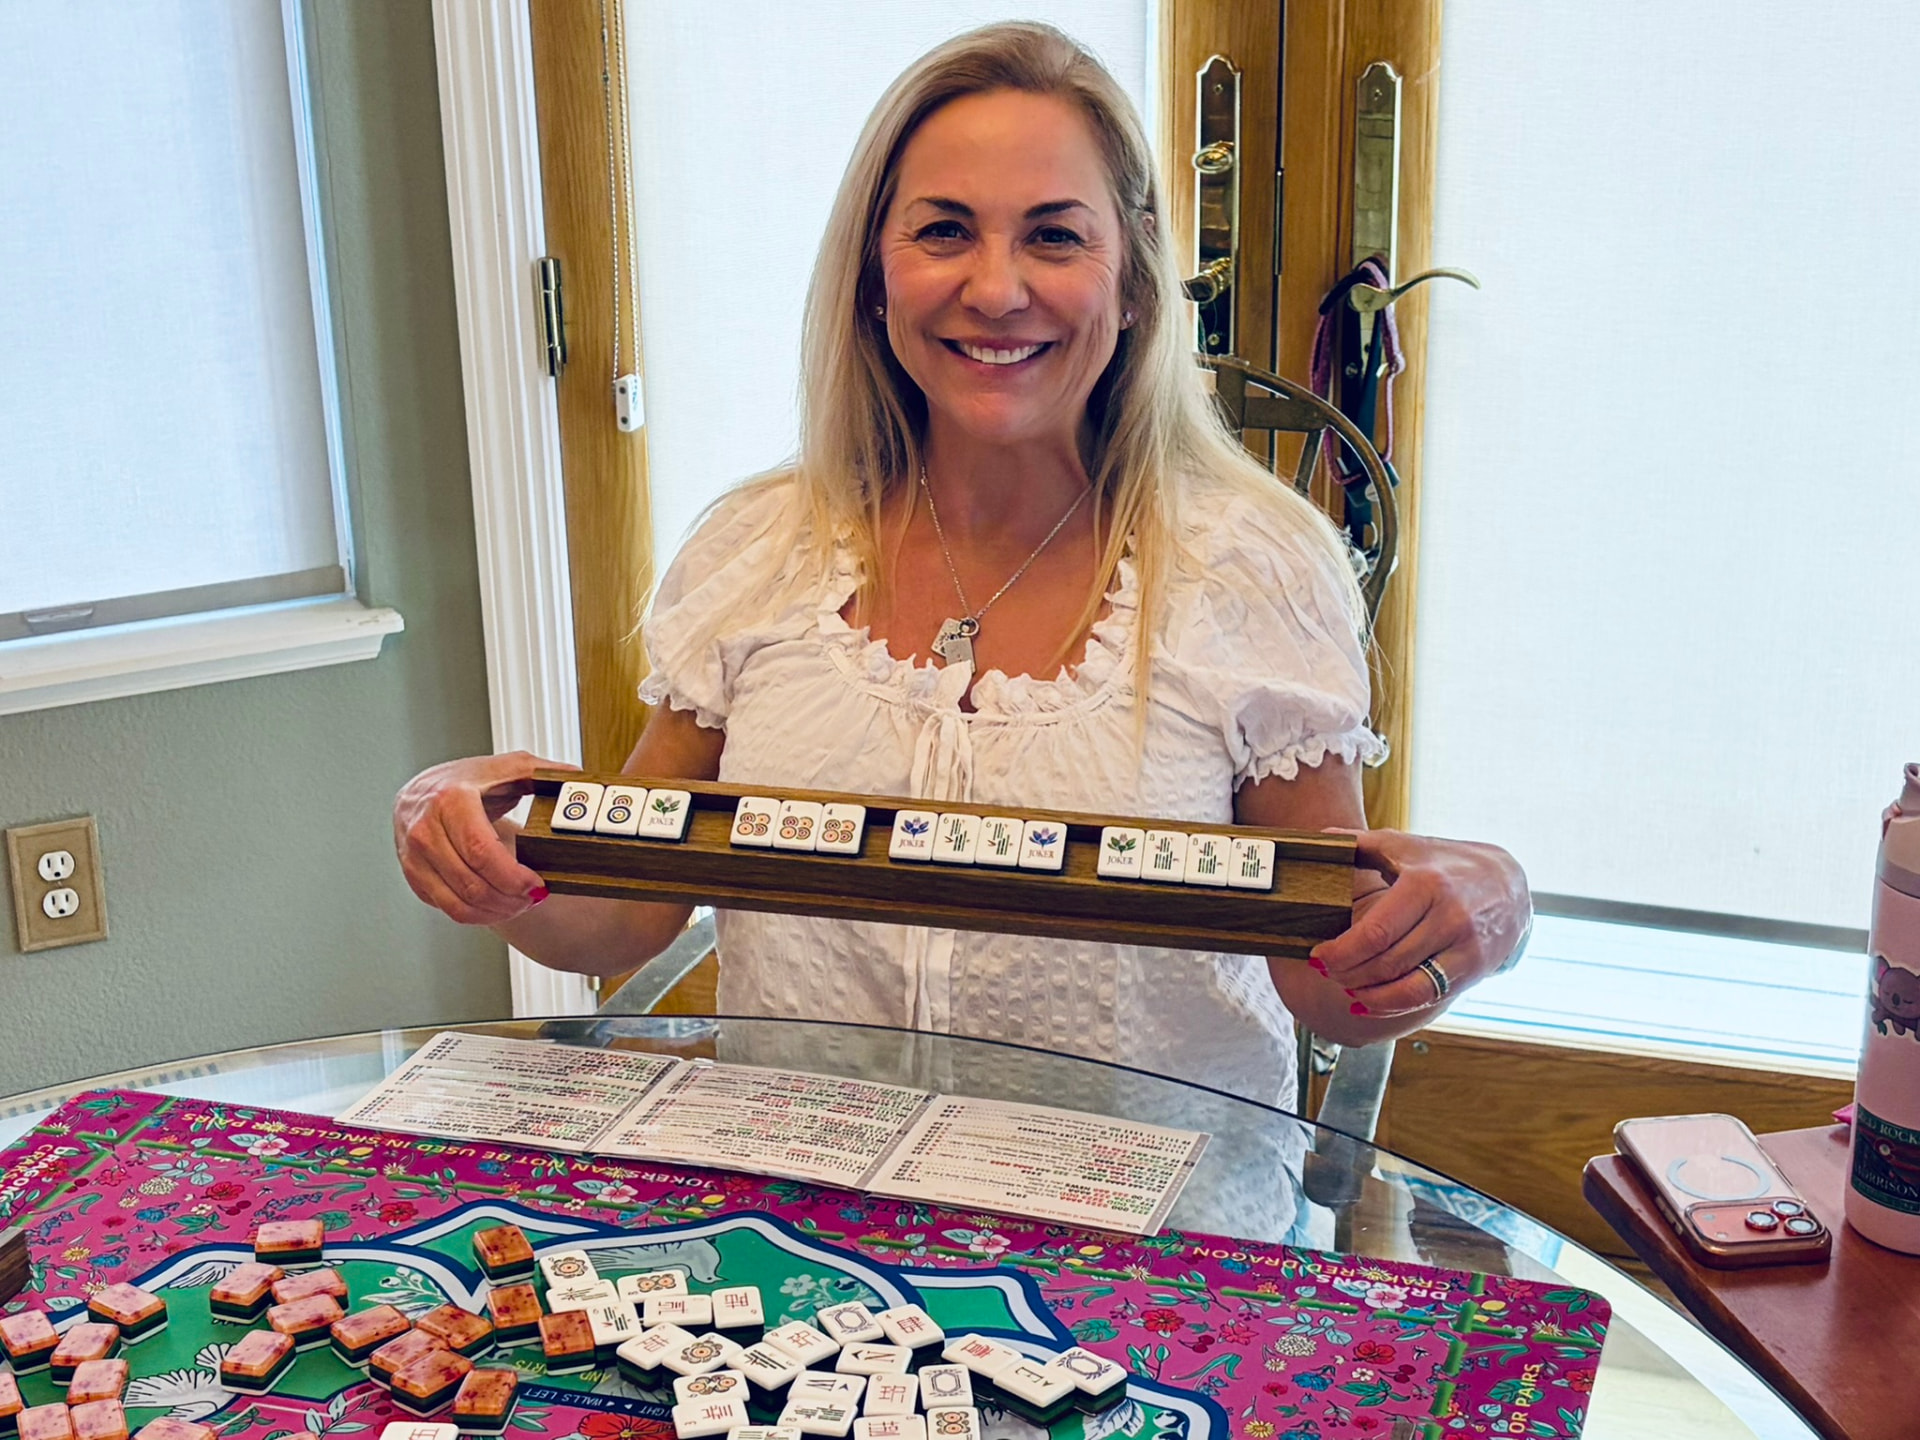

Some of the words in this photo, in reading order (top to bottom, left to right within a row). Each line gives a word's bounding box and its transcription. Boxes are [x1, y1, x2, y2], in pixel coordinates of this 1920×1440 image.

[647, 816, 675, 826] JOKER
[898, 838, 925, 849] JOKER
[1027, 849, 1055, 859] JOKER
[1106, 855, 1134, 866] JOKER
[181, 1113, 247, 1128] PAIRS
[289, 1127, 379, 1146] SINGLES
[1880, 1125, 1920, 1144] ROCK
[387, 1139, 411, 1149] IN
[416, 1144, 476, 1157] USED
[482, 1150, 511, 1161] BE
[515, 1156, 565, 1169] NOT
[628, 1170, 714, 1188] JOKERS
[1192, 1246, 1298, 1270] DRAGON
[1306, 1263, 1355, 1277] RED
[1315, 1273, 1448, 1301] DRAGONS
[580, 1371, 612, 1384] AND
[1515, 1363, 1541, 1407] PAIRS
[523, 1387, 558, 1400] LEFT
[561, 1392, 603, 1407] WALLS
[638, 1405, 673, 1417] IGHT
[1508, 1411, 1528, 1434] OR
